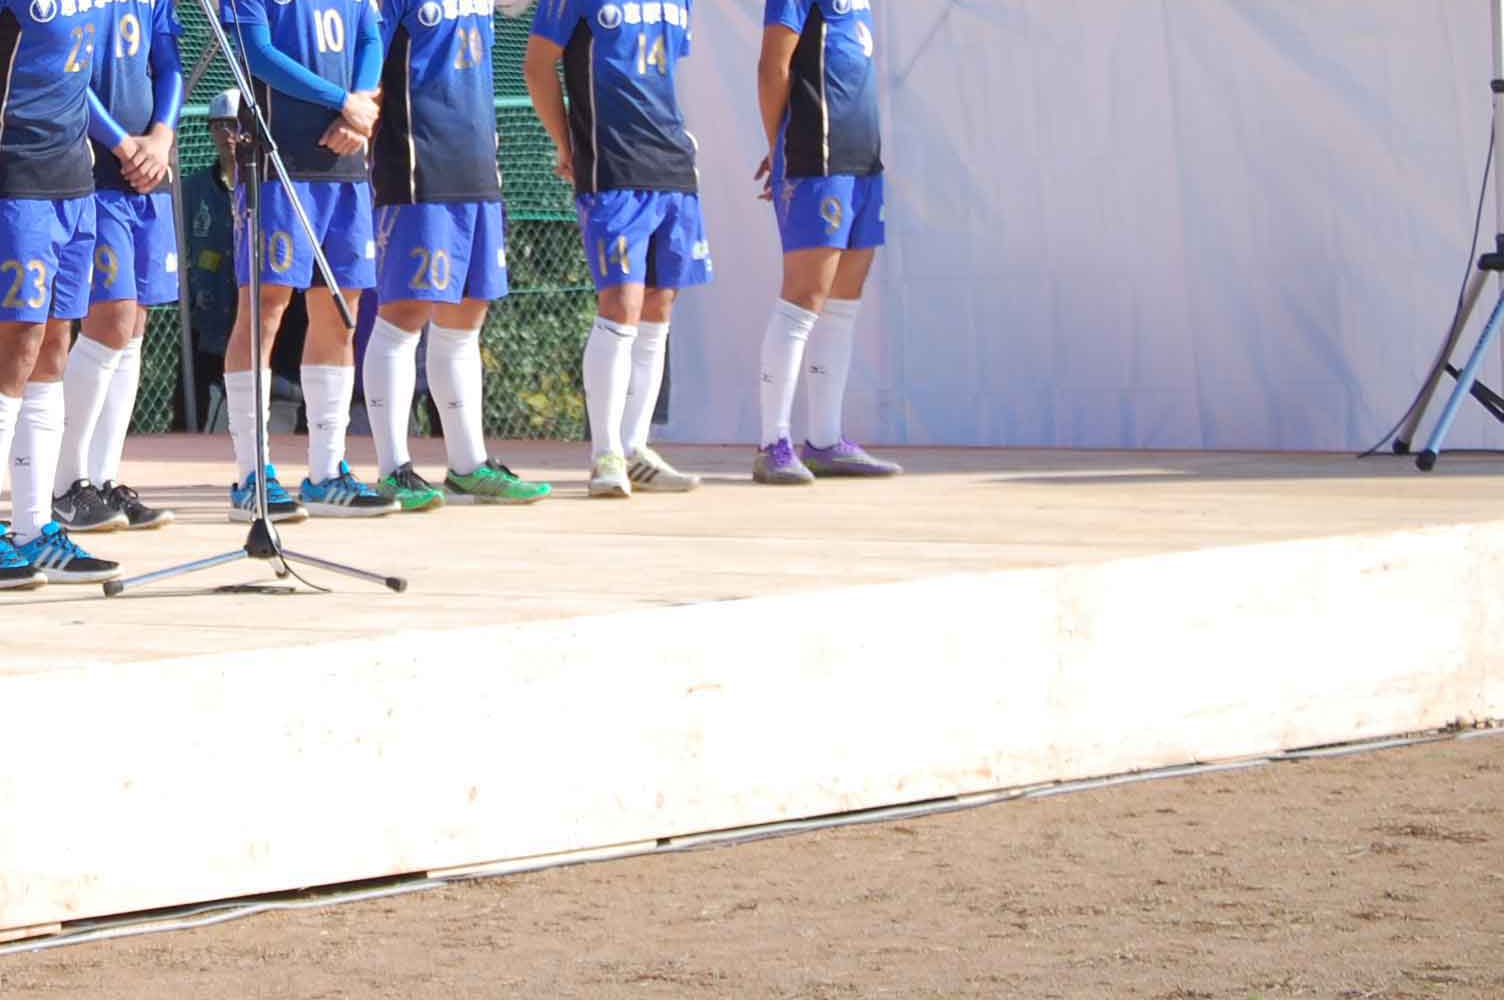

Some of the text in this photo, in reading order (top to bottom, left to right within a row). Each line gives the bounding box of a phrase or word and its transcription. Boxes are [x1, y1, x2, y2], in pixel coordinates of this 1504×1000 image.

[313, 8, 345, 53] 10
[636, 32, 667, 76] 14
[0, 258, 47, 309] 23
[410, 247, 452, 290] 20
